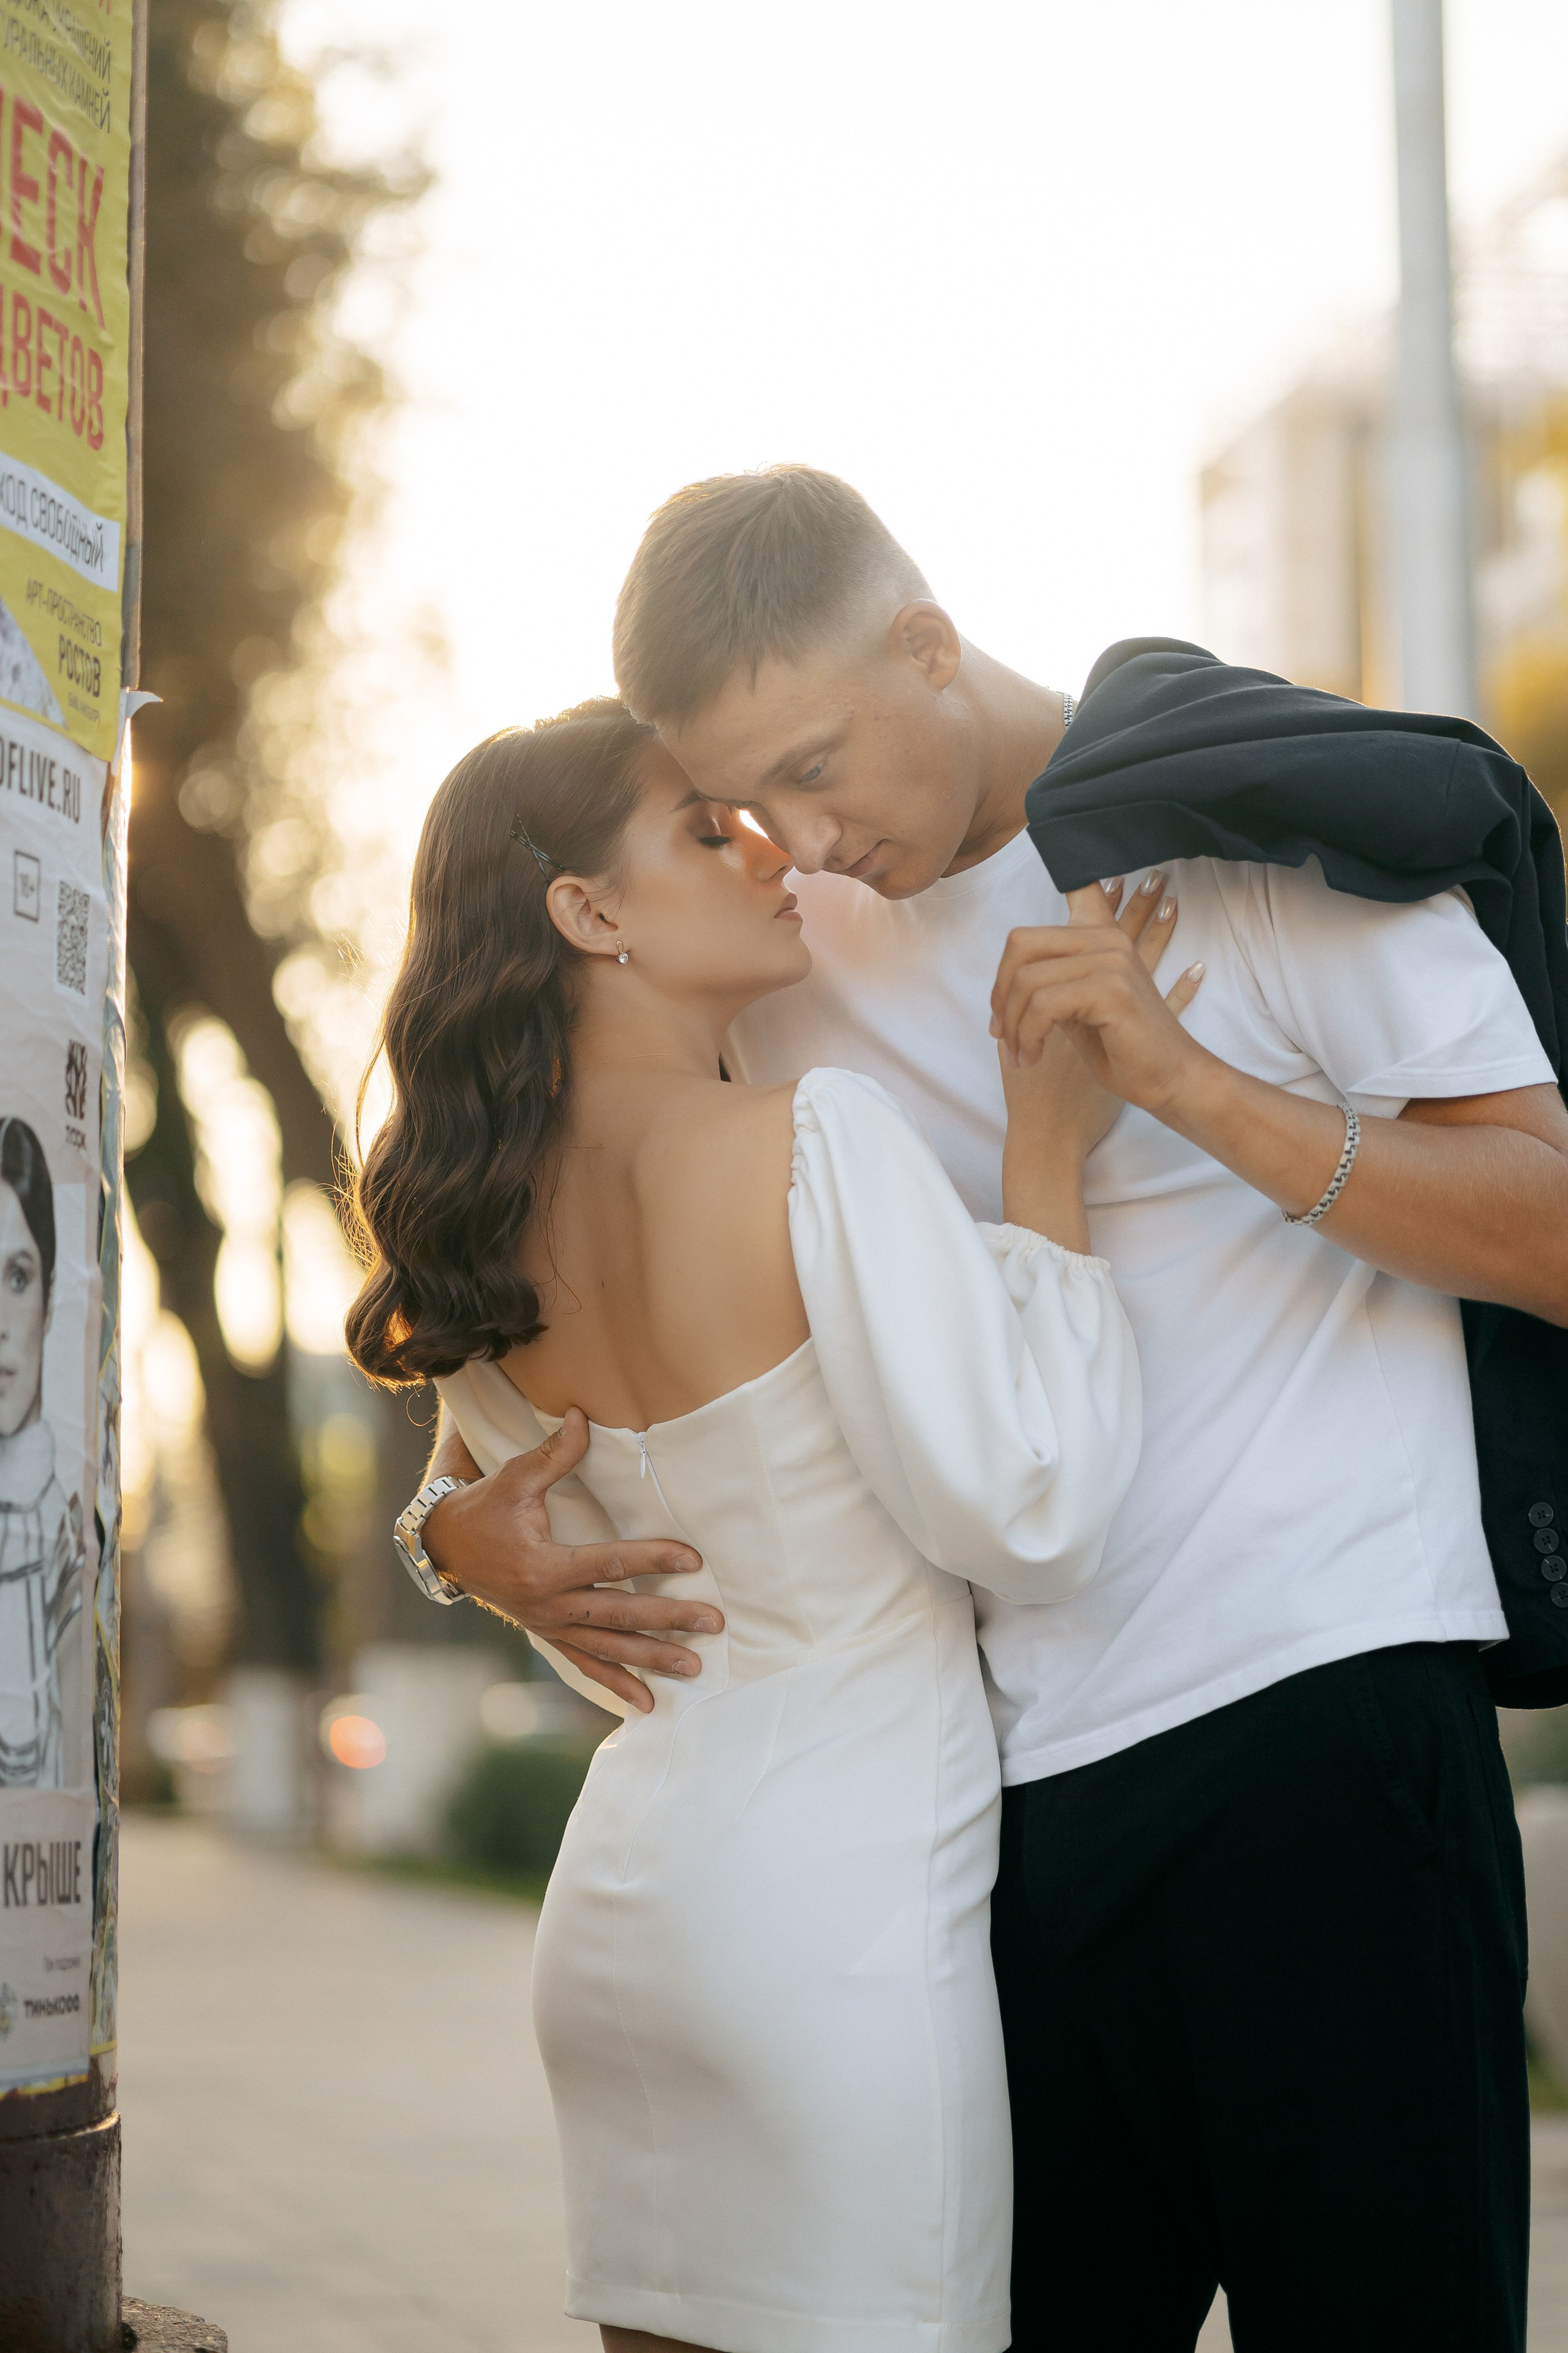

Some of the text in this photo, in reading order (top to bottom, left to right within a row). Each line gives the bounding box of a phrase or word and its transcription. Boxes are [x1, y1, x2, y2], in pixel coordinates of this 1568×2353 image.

[0, 83, 106, 331] ЕСК
[31, 488, 104, 572] СВОБОДНЫЙ
[58, 633, 101, 698] РОСТОВ
[3, 1840, 81, 1907] КРЫШЕ
